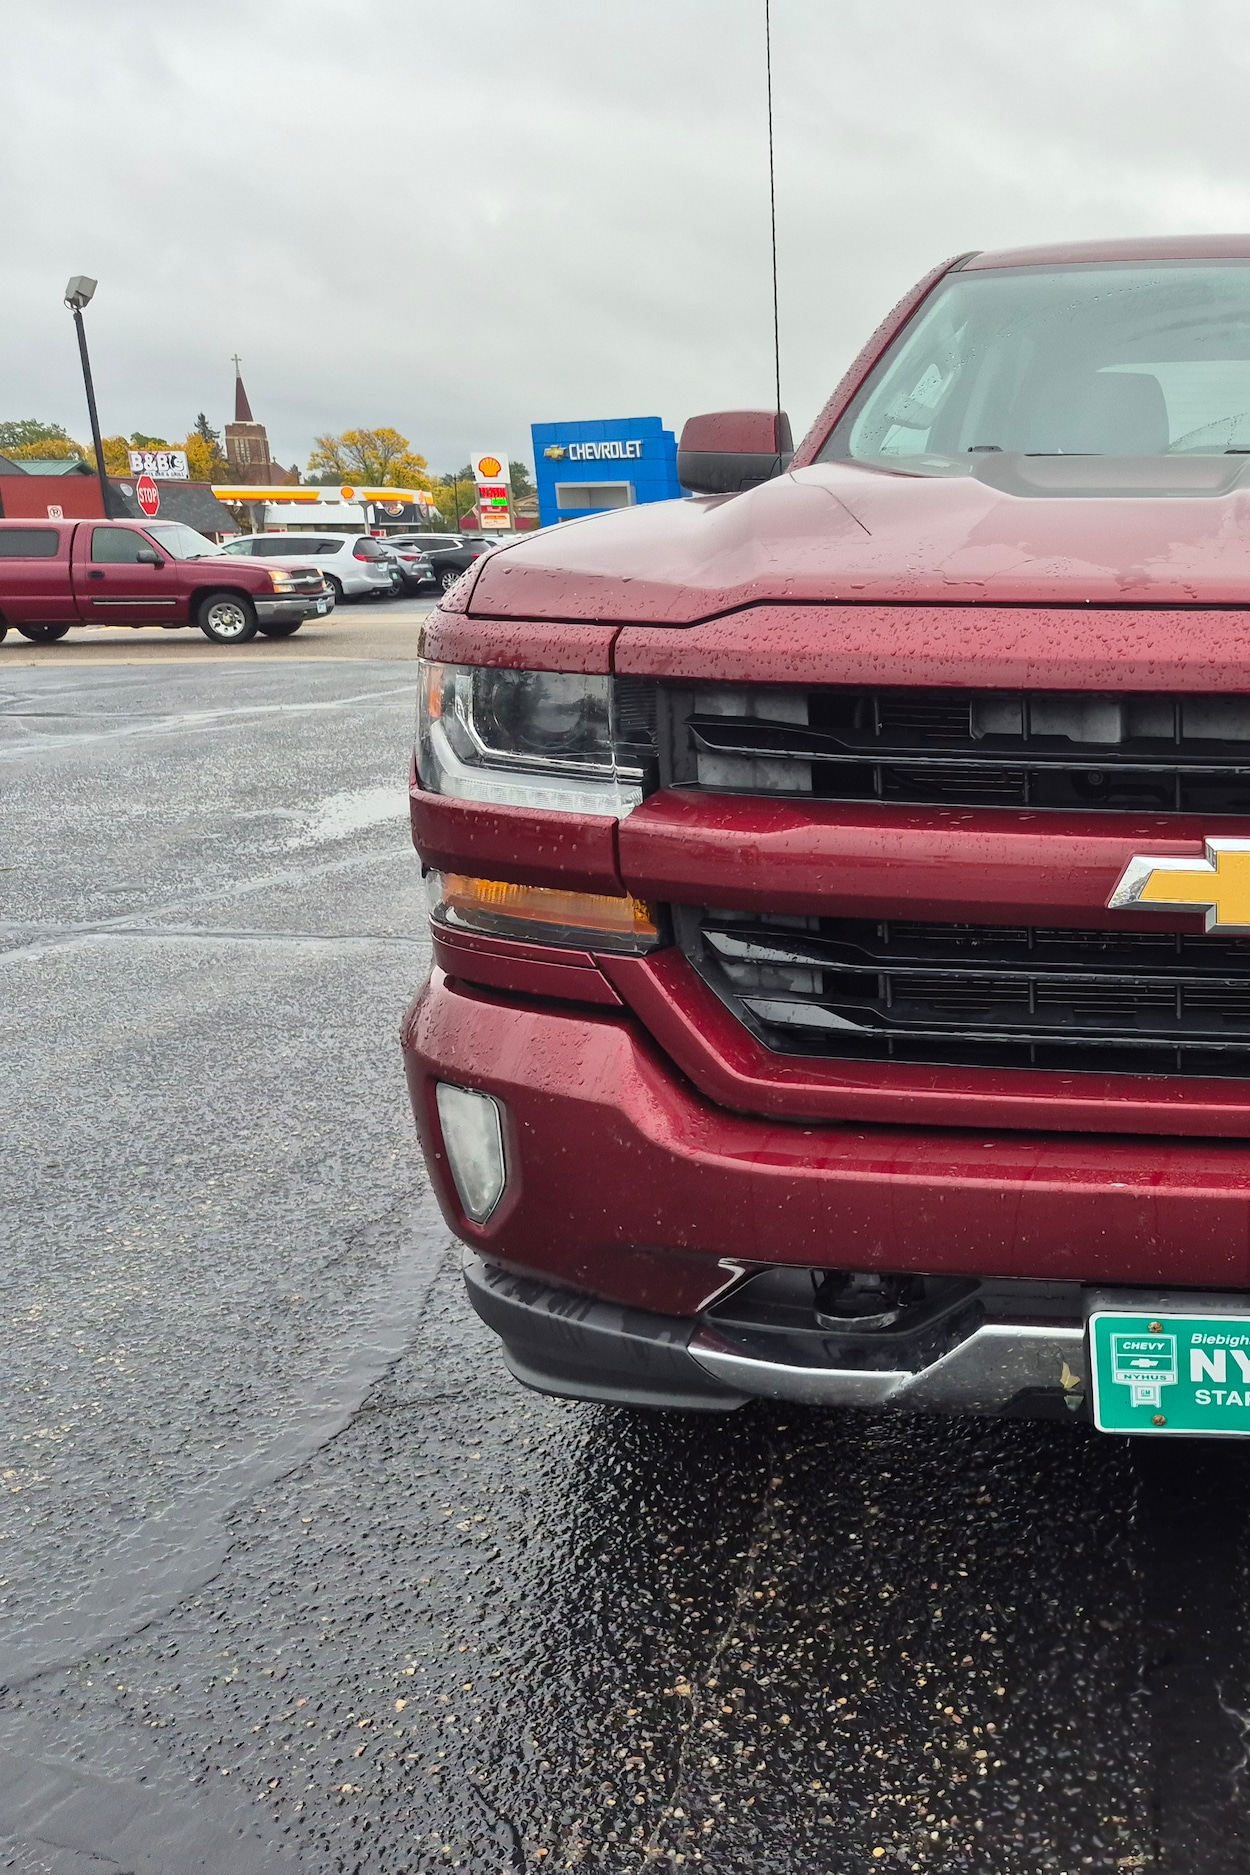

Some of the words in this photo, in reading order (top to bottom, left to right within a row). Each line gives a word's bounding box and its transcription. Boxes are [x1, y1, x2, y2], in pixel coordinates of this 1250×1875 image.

[568, 440, 642, 461] CHEVROLET
[138, 487, 157, 504] STOP
[1122, 1341, 1165, 1350] CHEVY
[1123, 1373, 1167, 1381] NYHUS
